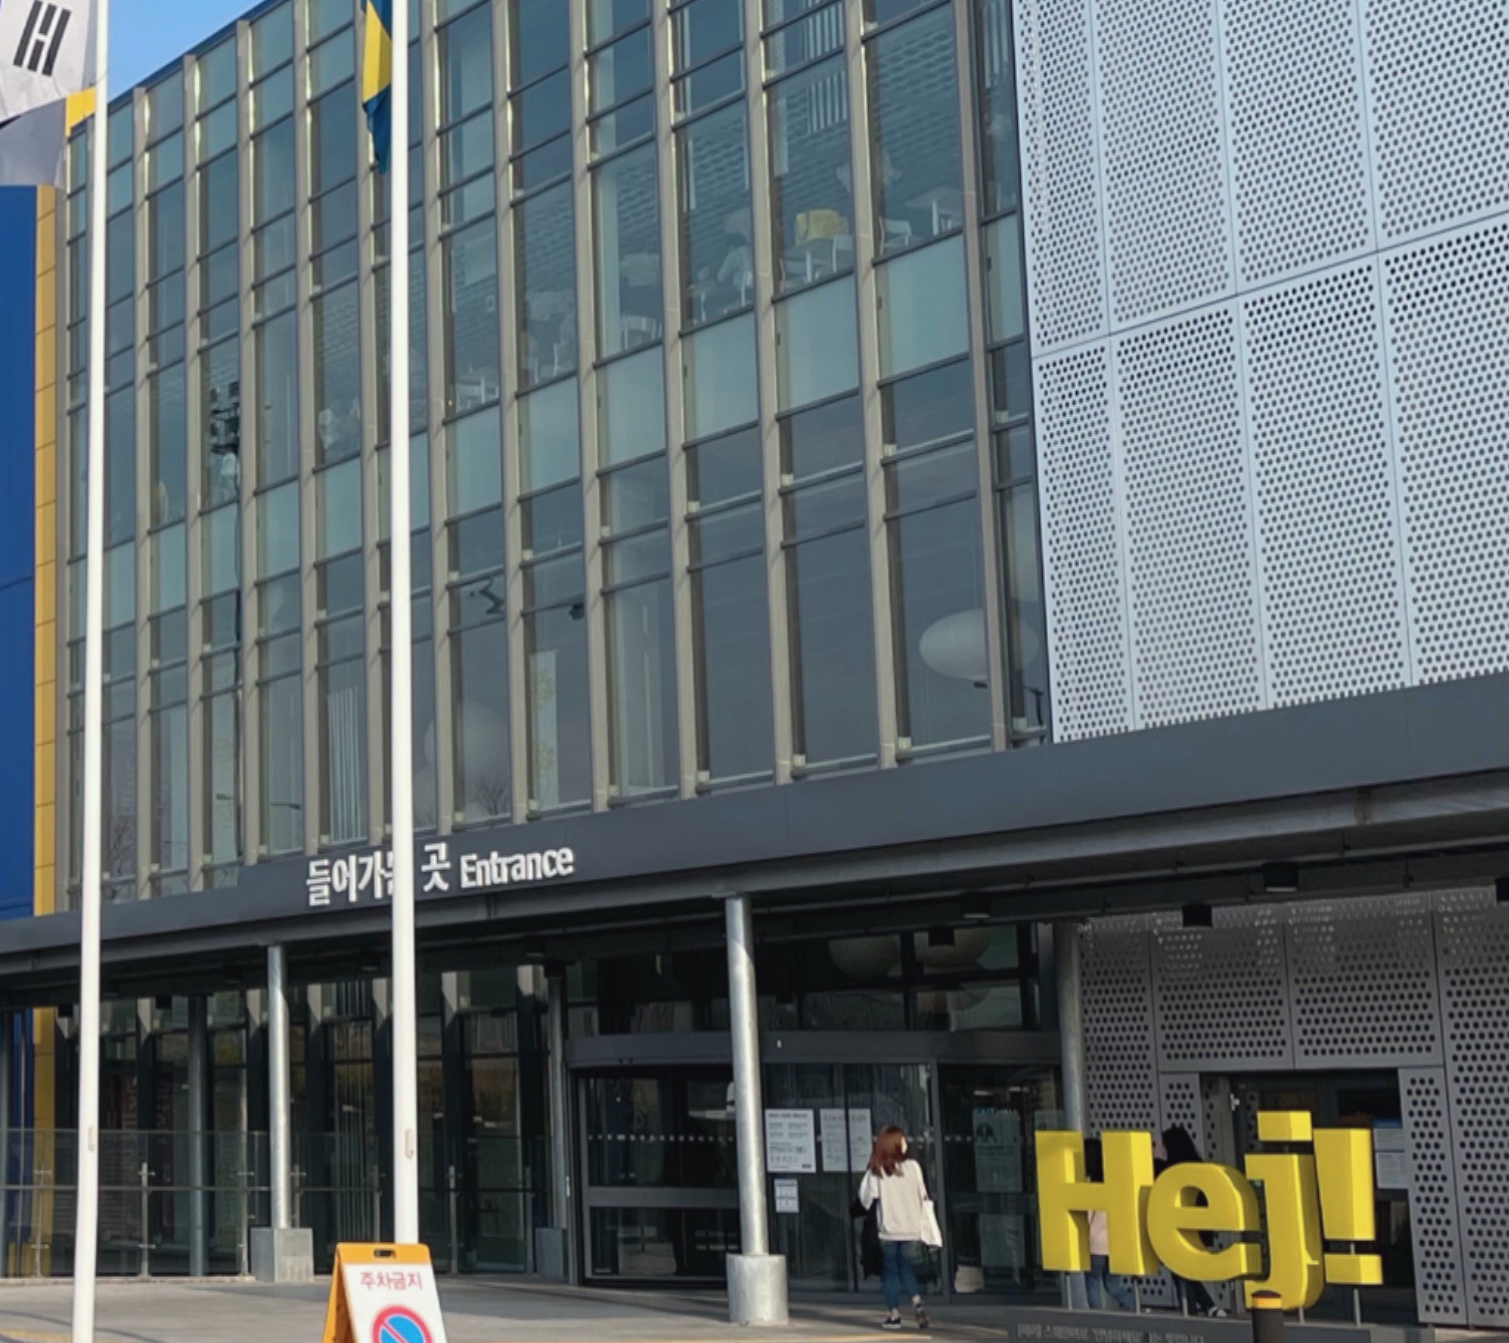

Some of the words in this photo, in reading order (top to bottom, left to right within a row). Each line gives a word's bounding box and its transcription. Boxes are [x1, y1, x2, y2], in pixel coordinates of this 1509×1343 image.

[306, 850, 395, 907] 들어가
[421, 841, 451, 892] 곳
[459, 846, 575, 889] Entrance
[1035, 1110, 1384, 1311] Hej!
[360, 1271, 424, 1291] 주차금지
